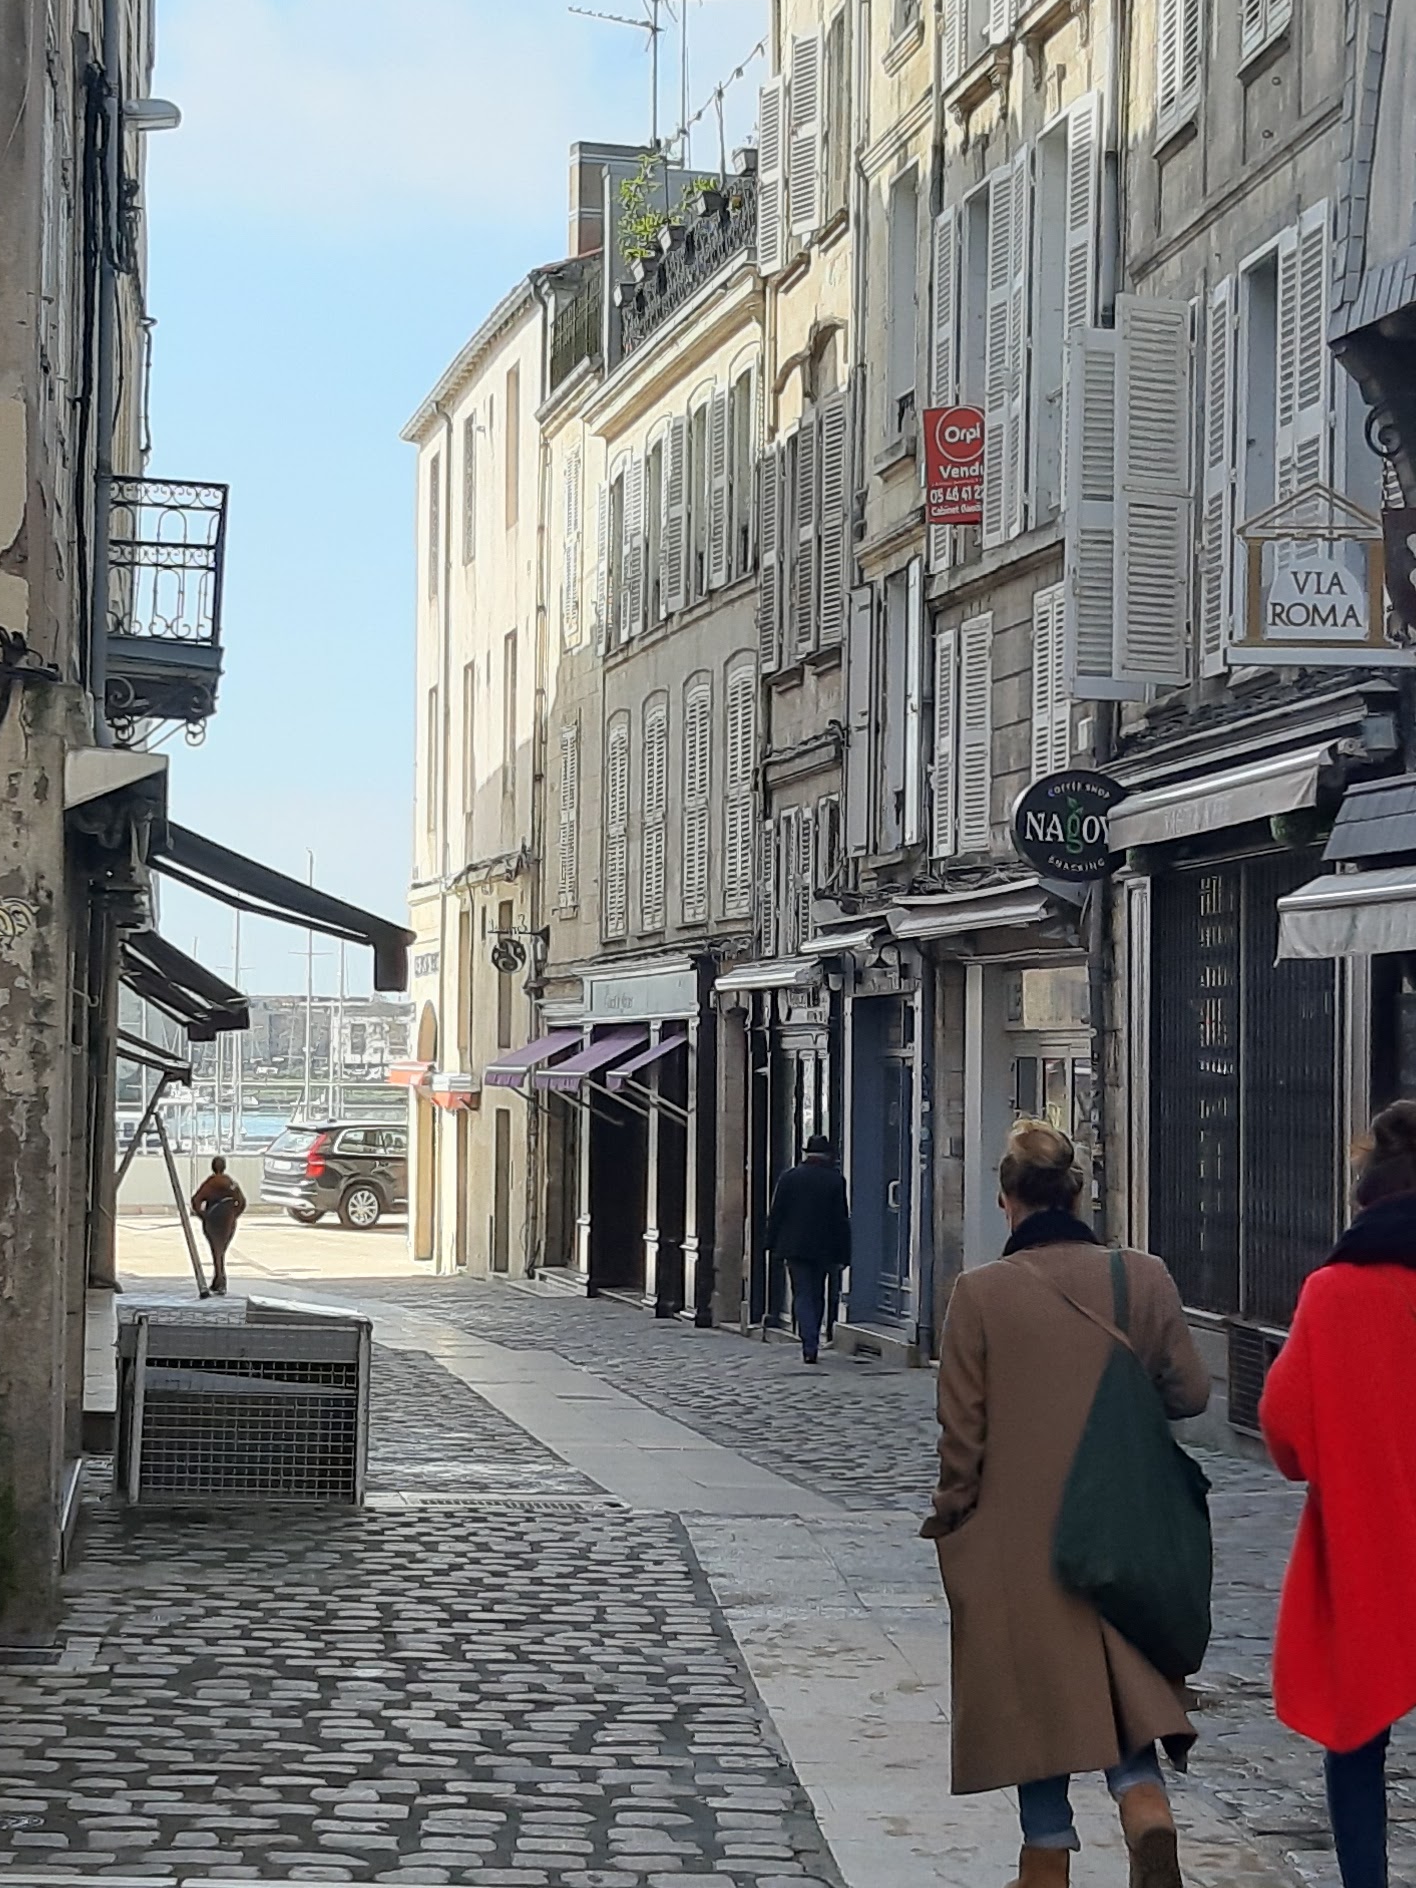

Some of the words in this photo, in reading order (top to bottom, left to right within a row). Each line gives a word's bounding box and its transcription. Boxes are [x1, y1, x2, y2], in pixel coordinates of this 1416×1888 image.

[944, 422, 981, 444] Orpi
[1290, 571, 1348, 596] VIA
[1267, 602, 1363, 628] ROMA
